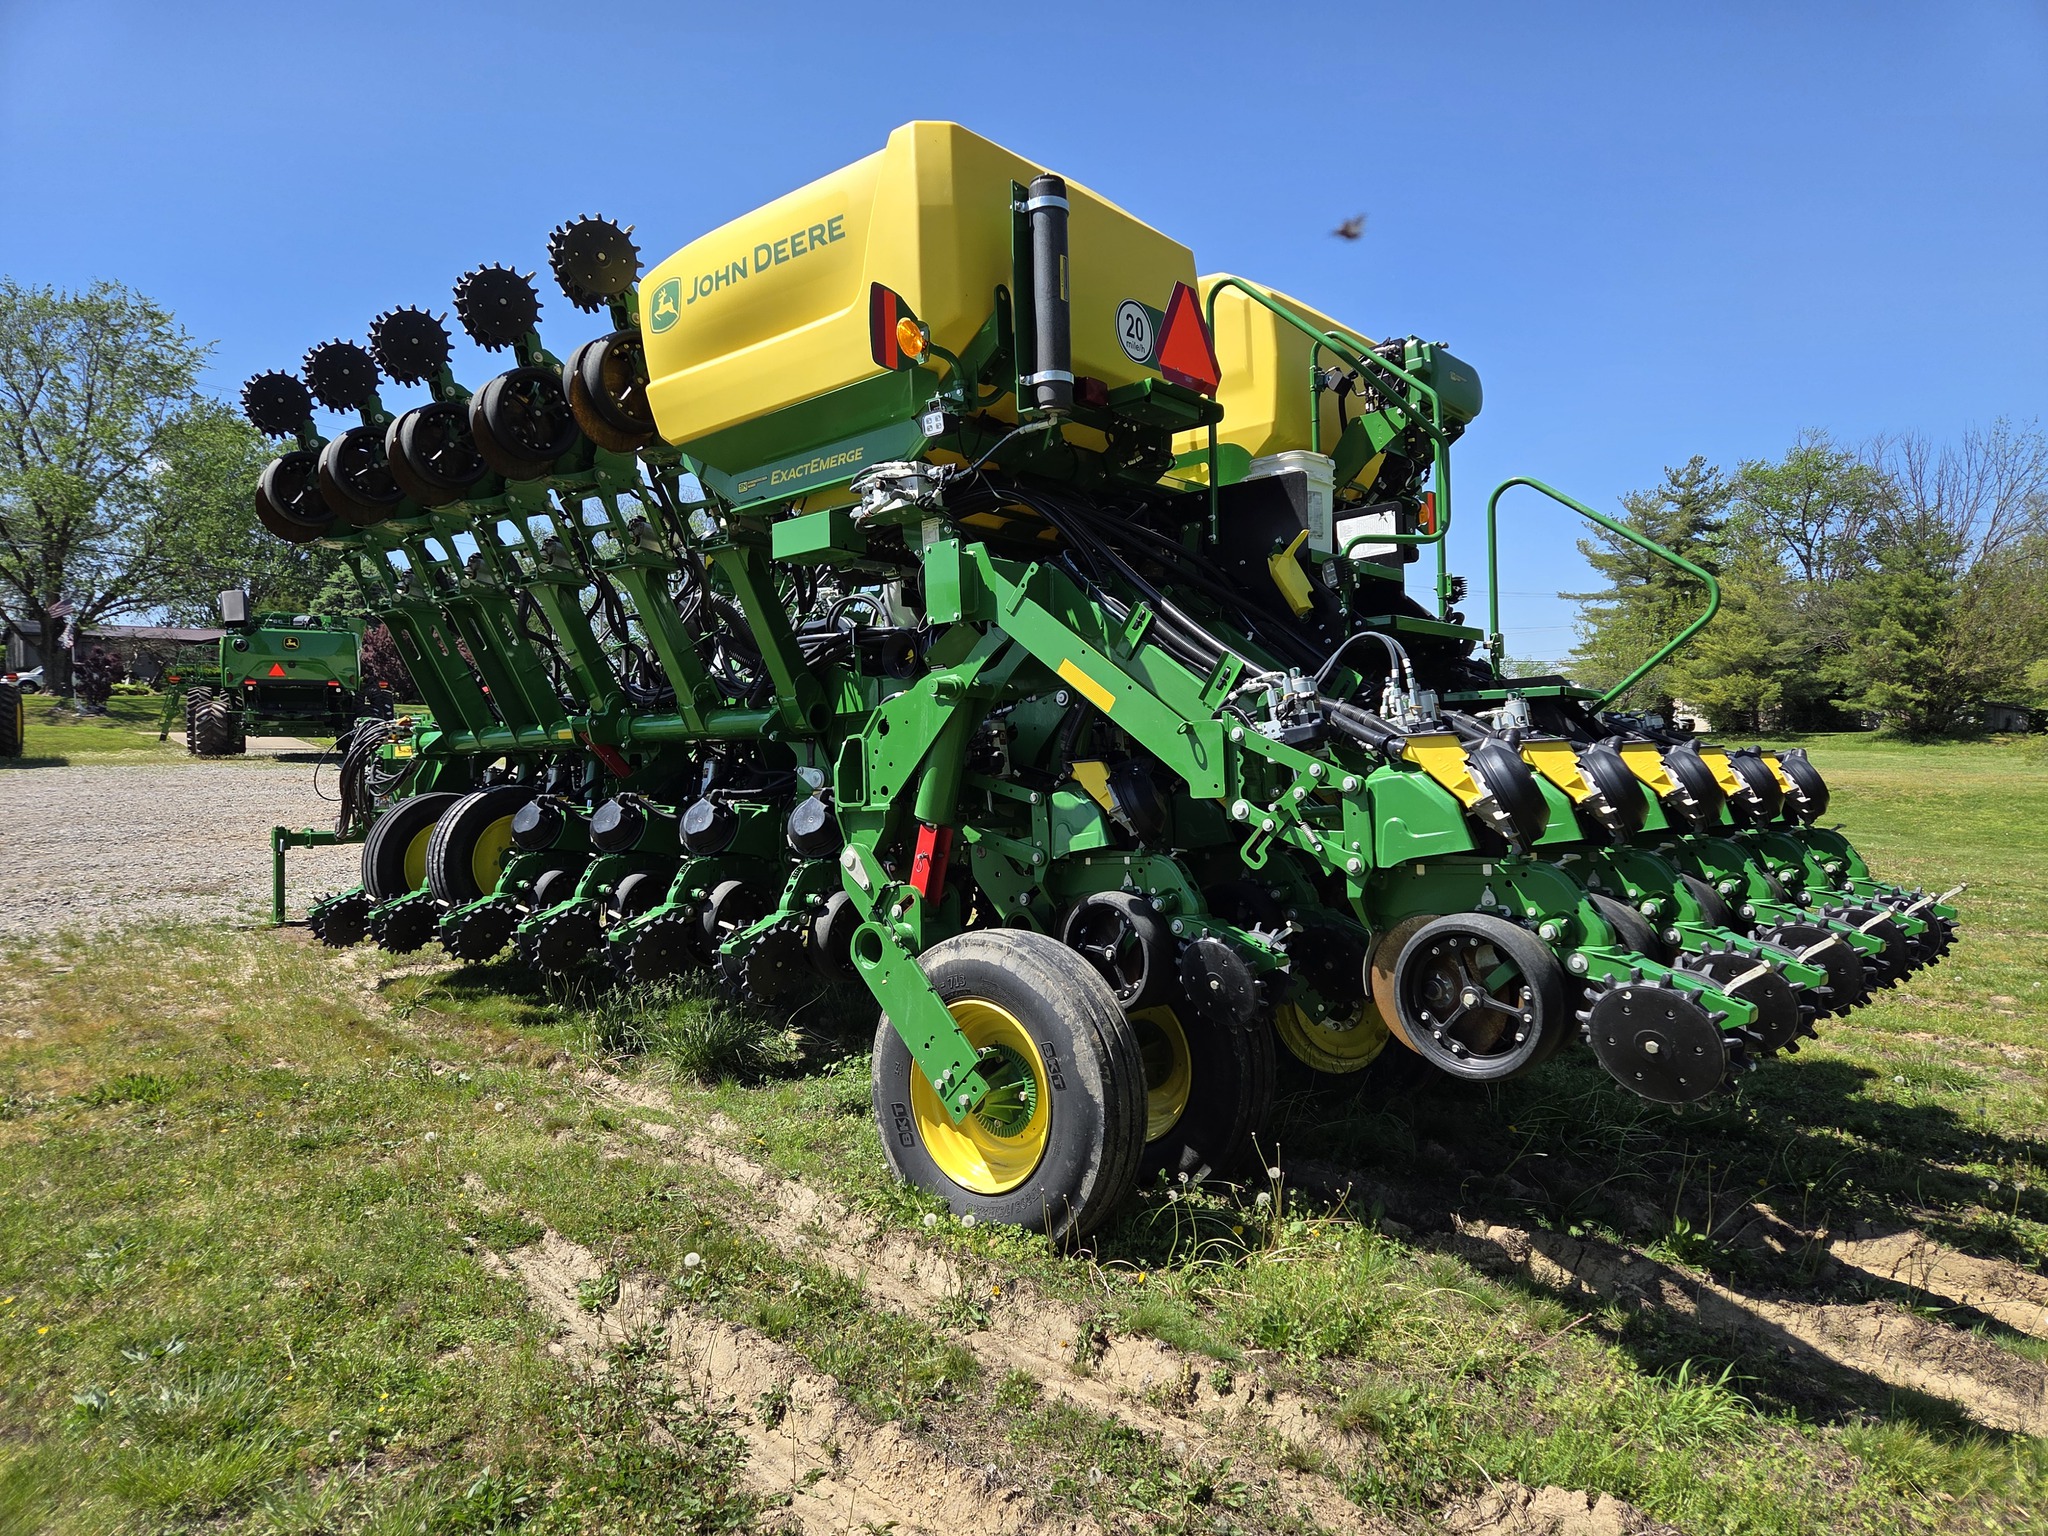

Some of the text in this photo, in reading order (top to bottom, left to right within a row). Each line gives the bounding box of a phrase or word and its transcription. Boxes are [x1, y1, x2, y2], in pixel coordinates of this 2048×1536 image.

[686, 214, 846, 305] JOHN DEERE
[1125, 313, 1144, 342] 20
[770, 447, 864, 486] EXACTEMERGE
[1041, 1041, 1067, 1091] BKT
[890, 1102, 916, 1148] BKT
